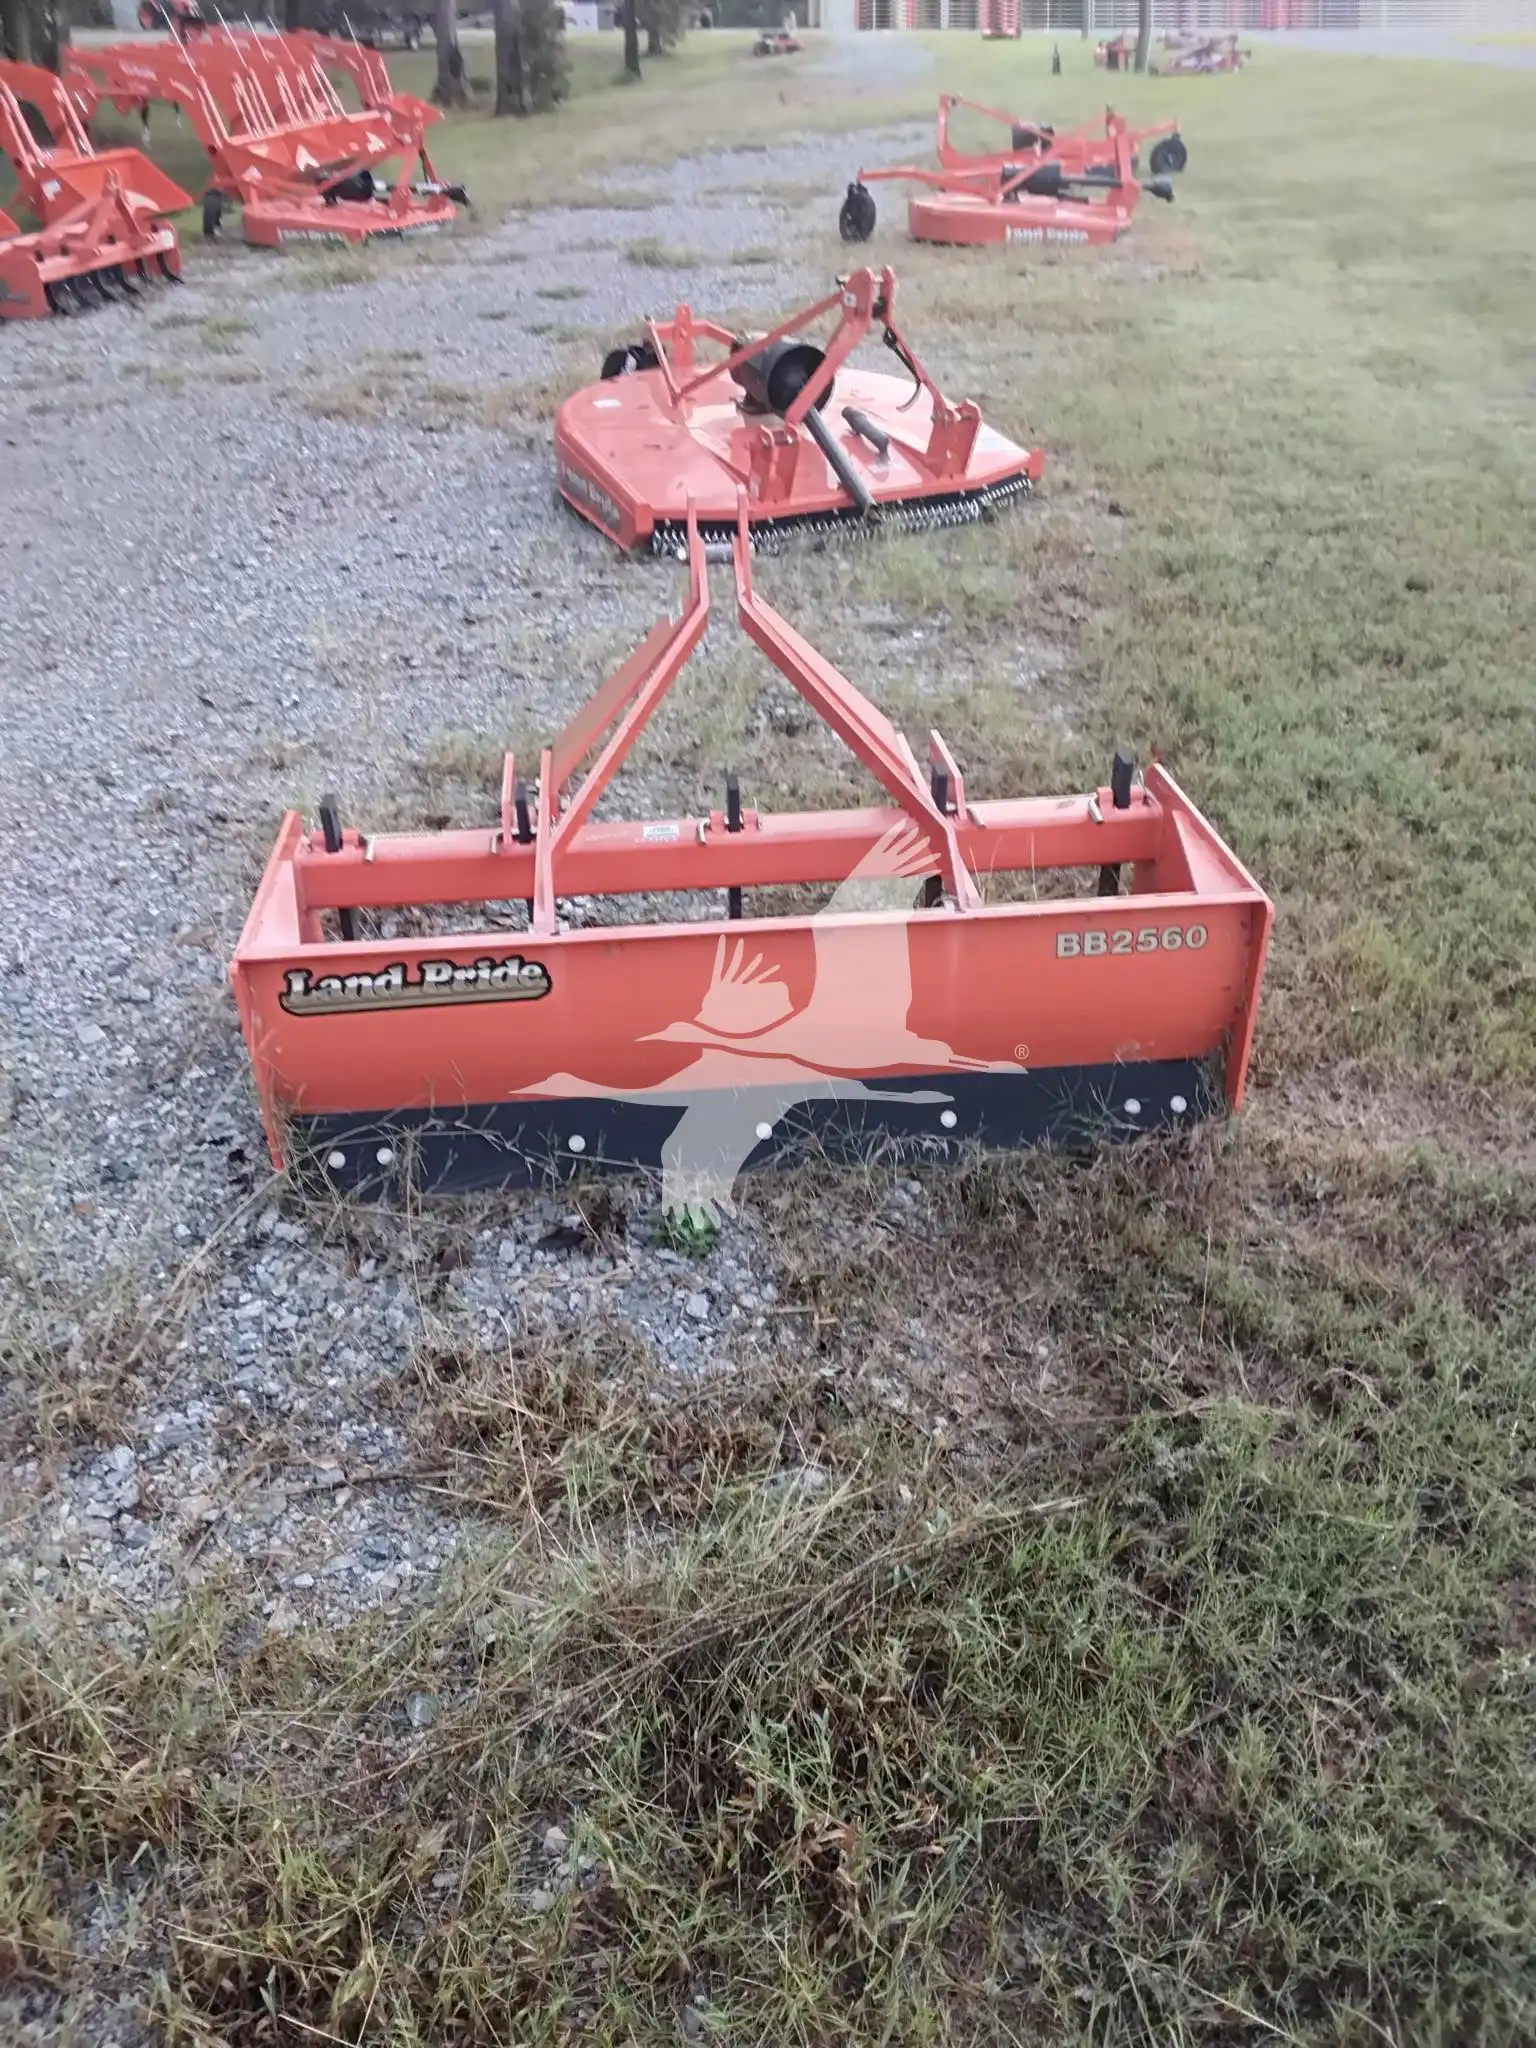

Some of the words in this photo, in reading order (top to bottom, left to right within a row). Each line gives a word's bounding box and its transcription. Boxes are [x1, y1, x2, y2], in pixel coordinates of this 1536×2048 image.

[1056, 924, 1208, 959] BB2560
[285, 967, 404, 1003] Land
[421, 956, 546, 995] Pride
